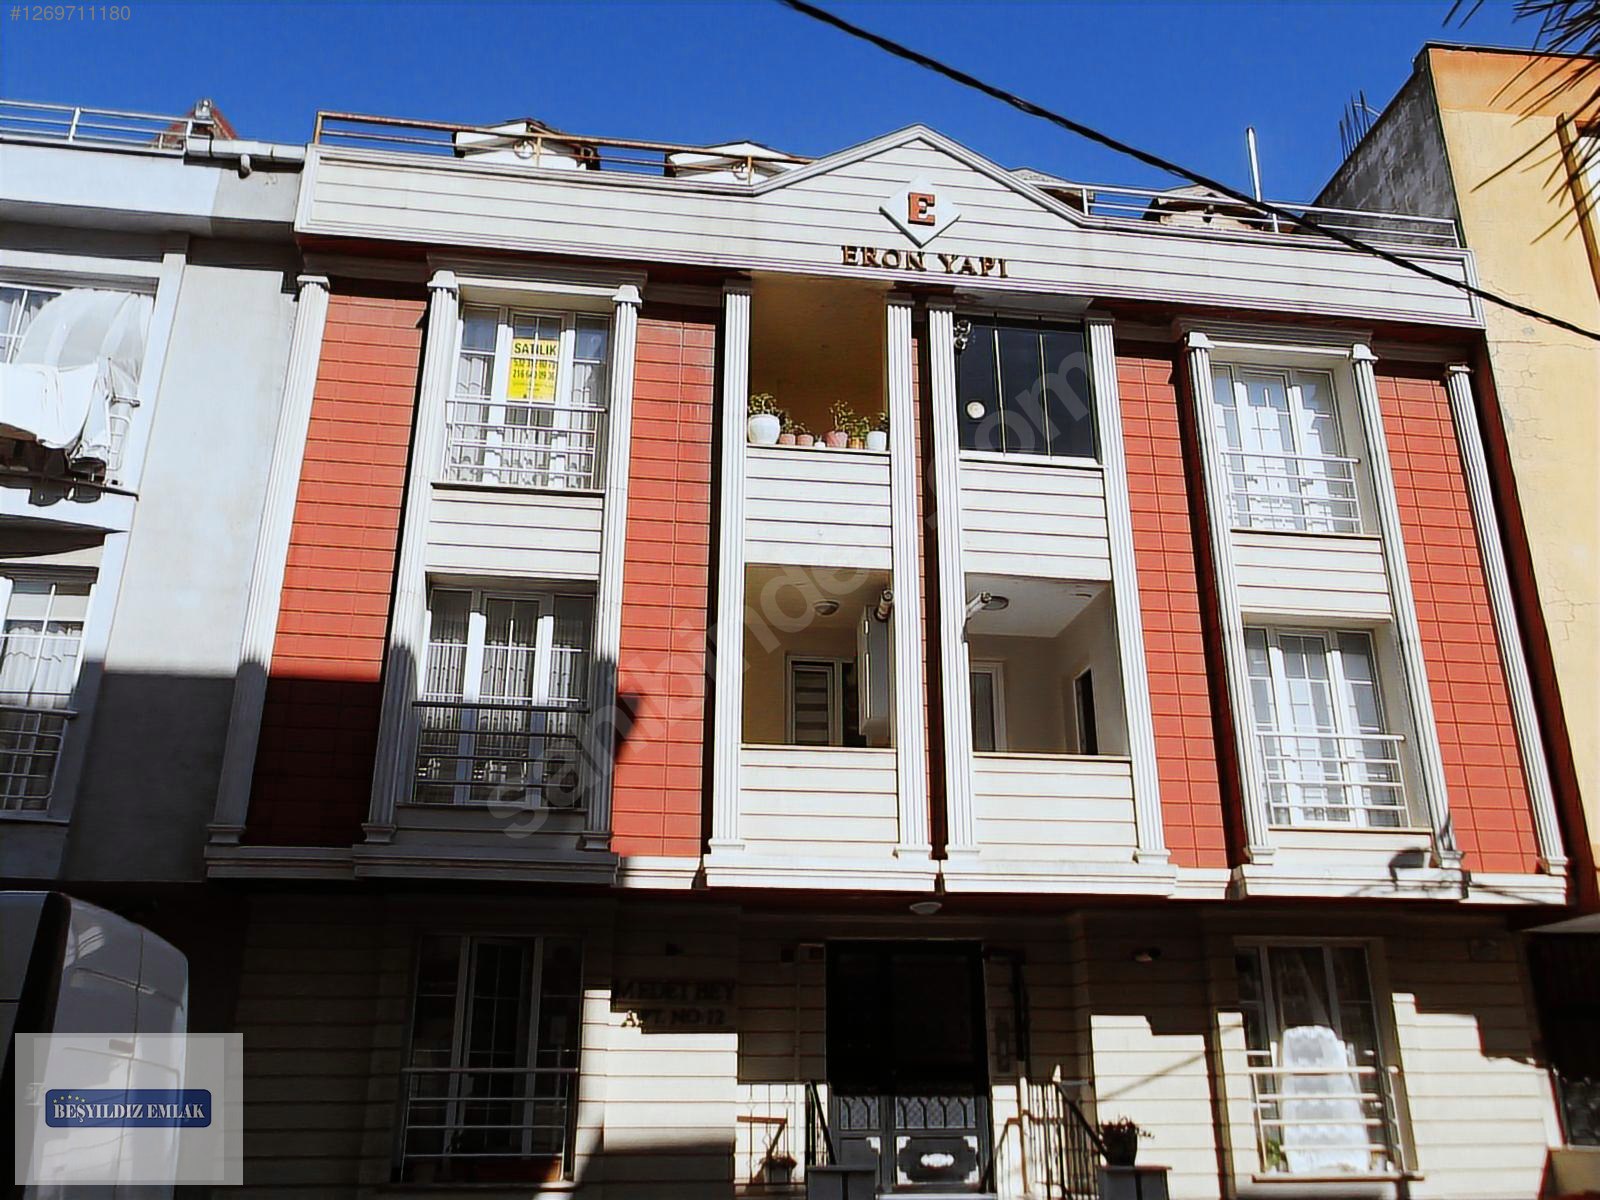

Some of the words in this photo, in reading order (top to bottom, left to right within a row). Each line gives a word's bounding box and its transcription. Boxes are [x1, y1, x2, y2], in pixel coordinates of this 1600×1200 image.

[907, 191, 936, 226] E
[841, 245, 927, 272] ERON
[937, 253, 1008, 278] YAPI
[514, 343, 556, 355] SATILIK
